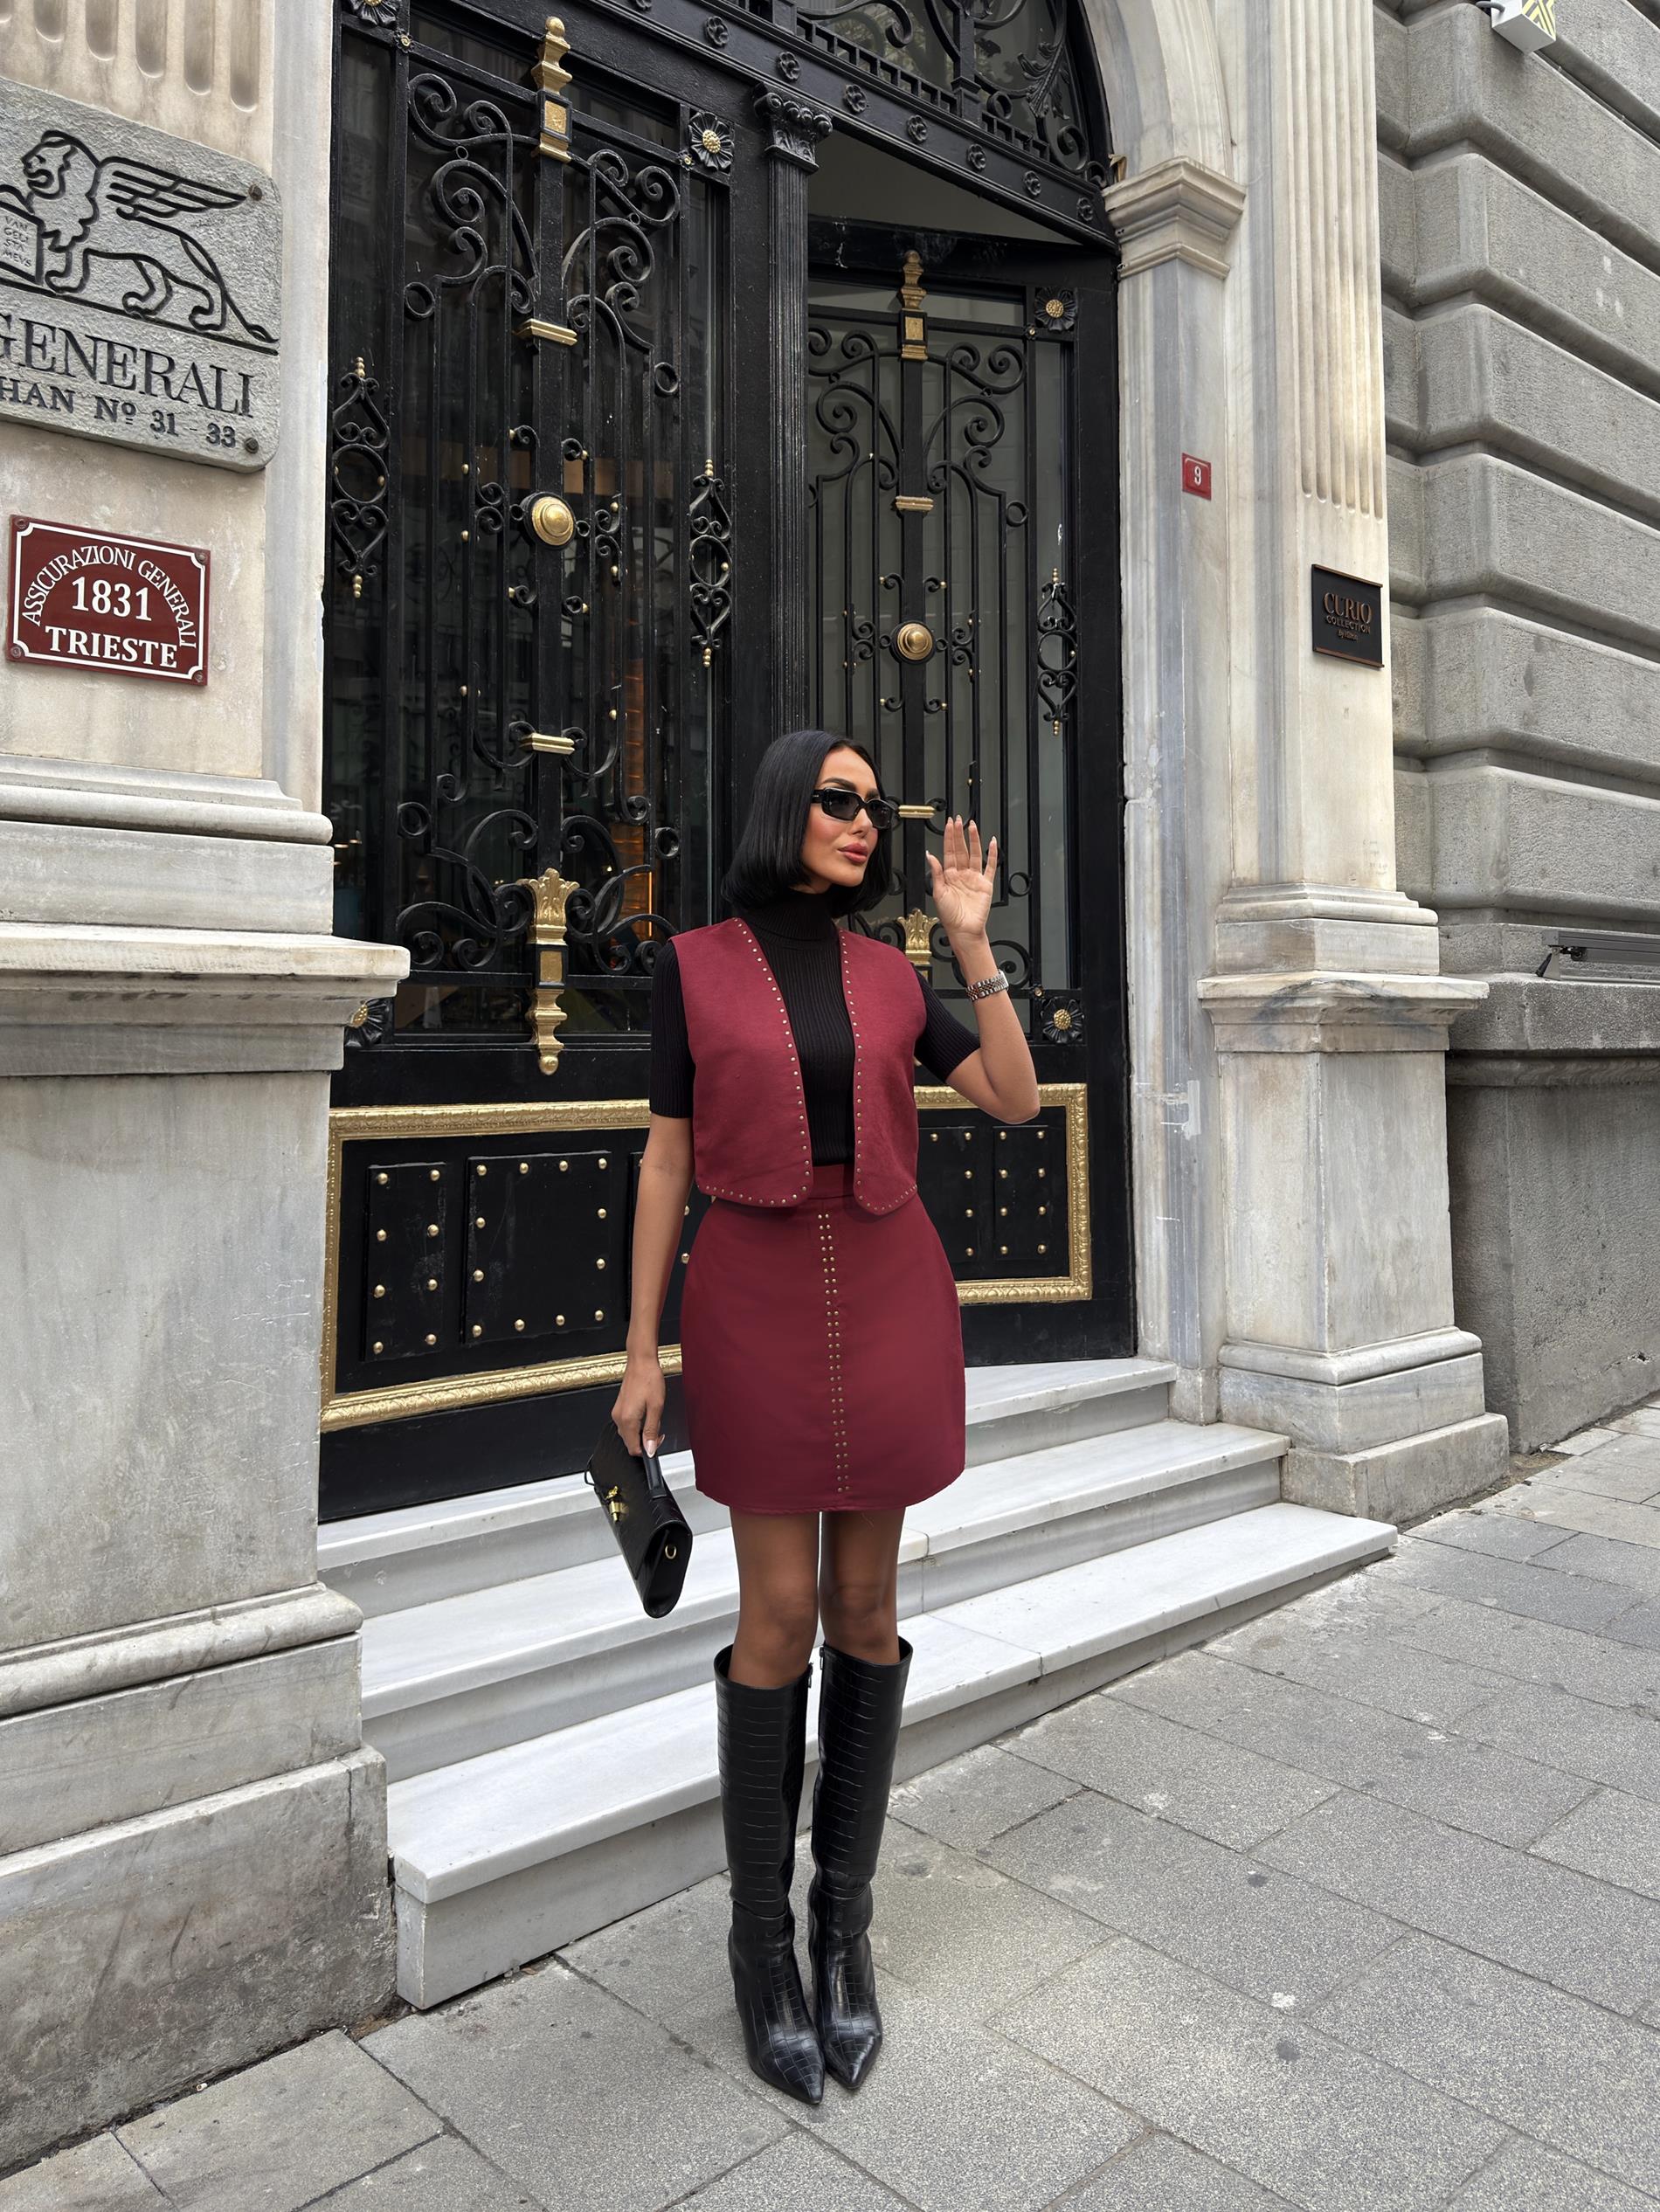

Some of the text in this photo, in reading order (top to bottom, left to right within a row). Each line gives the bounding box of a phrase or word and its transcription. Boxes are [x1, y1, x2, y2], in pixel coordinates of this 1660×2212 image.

[0, 375, 75, 414] HAN
[150, 409, 179, 437] 31
[206, 422, 237, 448] 33
[22, 545, 197, 648] ASSICURAZIONI GENERALI
[72, 577, 152, 621] 1831
[1324, 592, 1373, 624] CURIO
[1326, 614, 1371, 634] COLLECTION
[45, 626, 177, 668] TRIESTE
